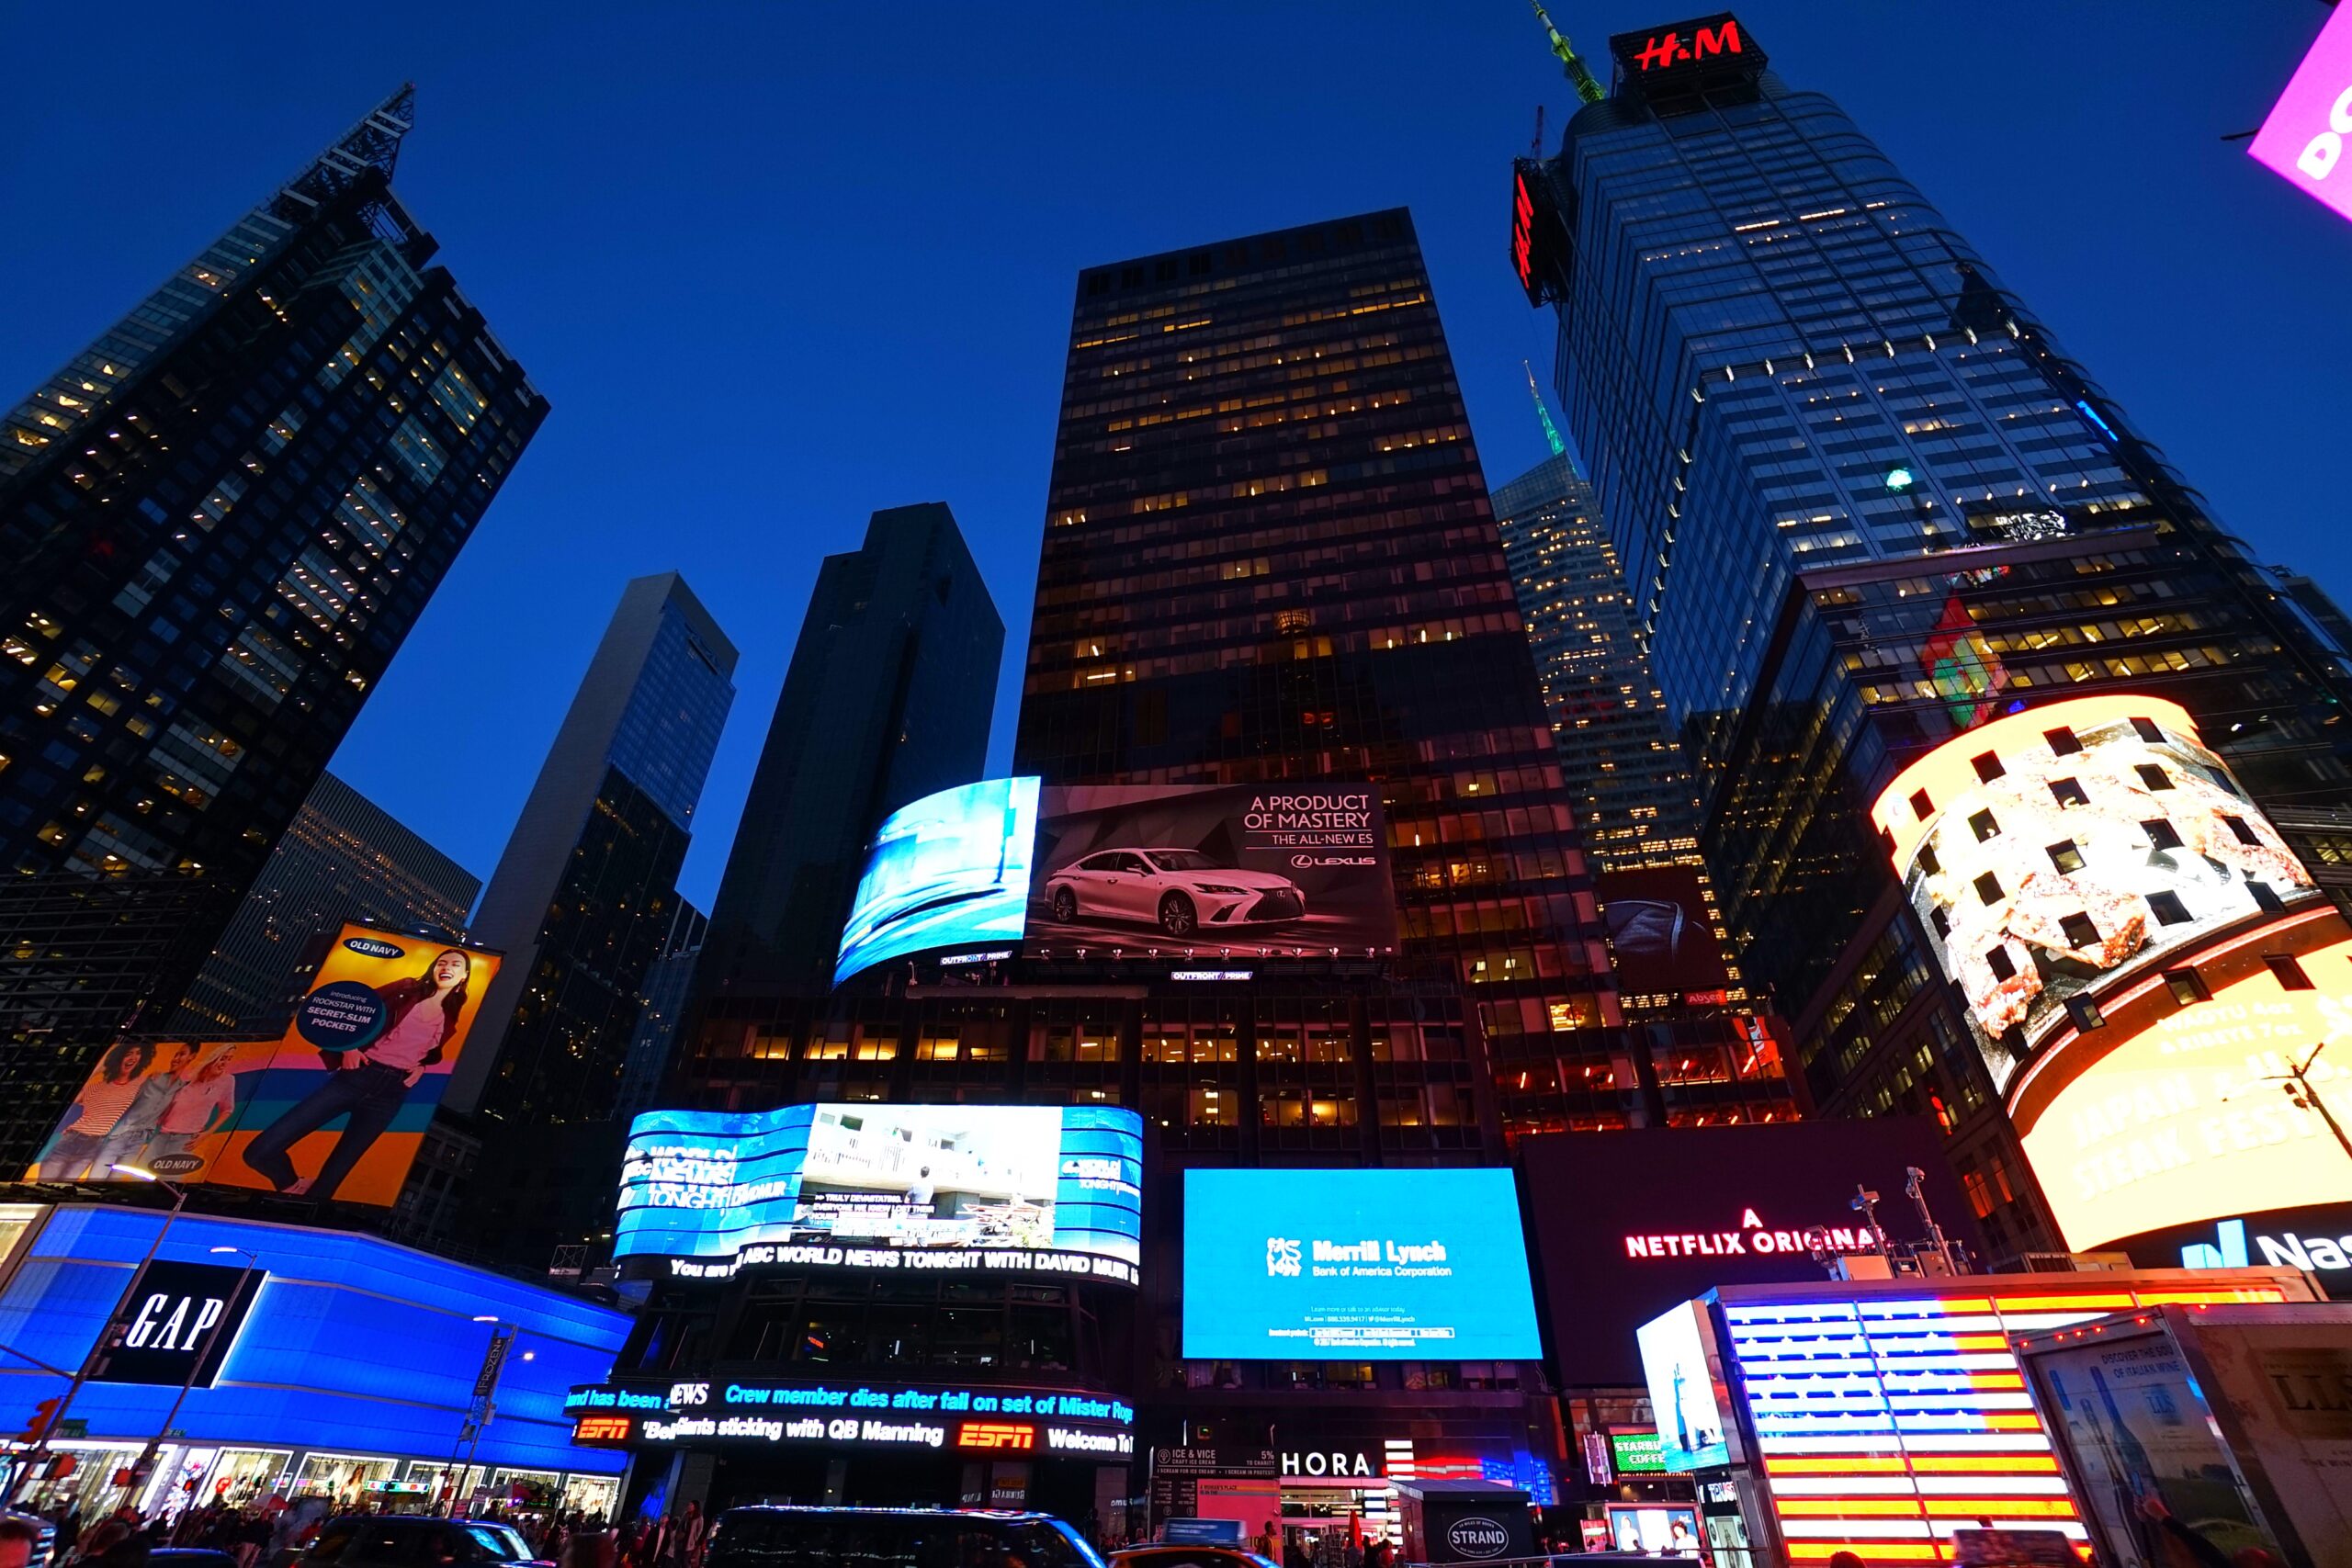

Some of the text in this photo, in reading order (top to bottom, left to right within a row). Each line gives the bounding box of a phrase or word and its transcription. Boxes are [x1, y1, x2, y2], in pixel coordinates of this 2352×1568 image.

[1633, 20, 1742, 71] H&M
[1250, 795, 1369, 811] A PRODUCT
[1244, 812, 1371, 829] OF MASTERY
[1272, 833, 1374, 845] THE ALL-NEW ES
[1315, 857, 1376, 865] LEXUS
[350, 940, 399, 956] OLD NAVY
[312, 997, 376, 1014] ROCKSTAR WITH
[330, 991, 368, 1003] introducing
[307, 1006, 371, 1023] SECRET-SLIM
[311, 1018, 356, 1032] POCKETS
[2072, 1073, 2199, 1151] JAPAN
[153, 1160, 198, 1169] OLD NAVY
[2073, 1127, 2193, 1201] STEAK
[1743, 1209, 1763, 1228] A
[1312, 1240, 1447, 1265] Merrill Lynch
[1625, 1233, 1746, 1258] NETFLIX
[671, 1259, 703, 1276] You
[743, 1247, 775, 1264] ABC
[776, 1247, 843, 1265] WORLD
[845, 1247, 901, 1268] NEWS
[902, 1250, 982, 1269] TONIGHT
[983, 1251, 1034, 1269] WITH
[1035, 1253, 1091, 1273] DAVID
[1312, 1266, 1453, 1278] Bank of America Corporation
[125, 1292, 224, 1351] GAP
[2101, 1350, 2138, 1365] DISCOVER
[477, 1344, 503, 1389] FROZEN
[589, 1390, 616, 1406] has
[617, 1391, 662, 1409] been
[726, 1384, 773, 1404] Crew
[775, 1387, 848, 1406] member
[850, 1388, 889, 1408] dies
[892, 1390, 938, 1410] after
[940, 1392, 970, 1411] fall
[973, 1397, 997, 1411] on
[1001, 1396, 1032, 1413] set
[1035, 1396, 1056, 1415] of
[1058, 1396, 1111, 1417] Mister
[578, 1419, 629, 1439] ESPN
[718, 1417, 783, 1440] sticking
[786, 1418, 824, 1438] with
[829, 1420, 858, 1439] QB
[862, 1421, 944, 1448] Manning
[958, 1424, 1035, 1449] ESPN
[1047, 1428, 1117, 1452] Welcome
[1172, 1449, 1216, 1459] ICE & VICE
[1261, 1450, 1275, 1460] 5%
[1628, 1451, 1667, 1465] COFFE
[1452, 1530, 1505, 1544] STRAND
